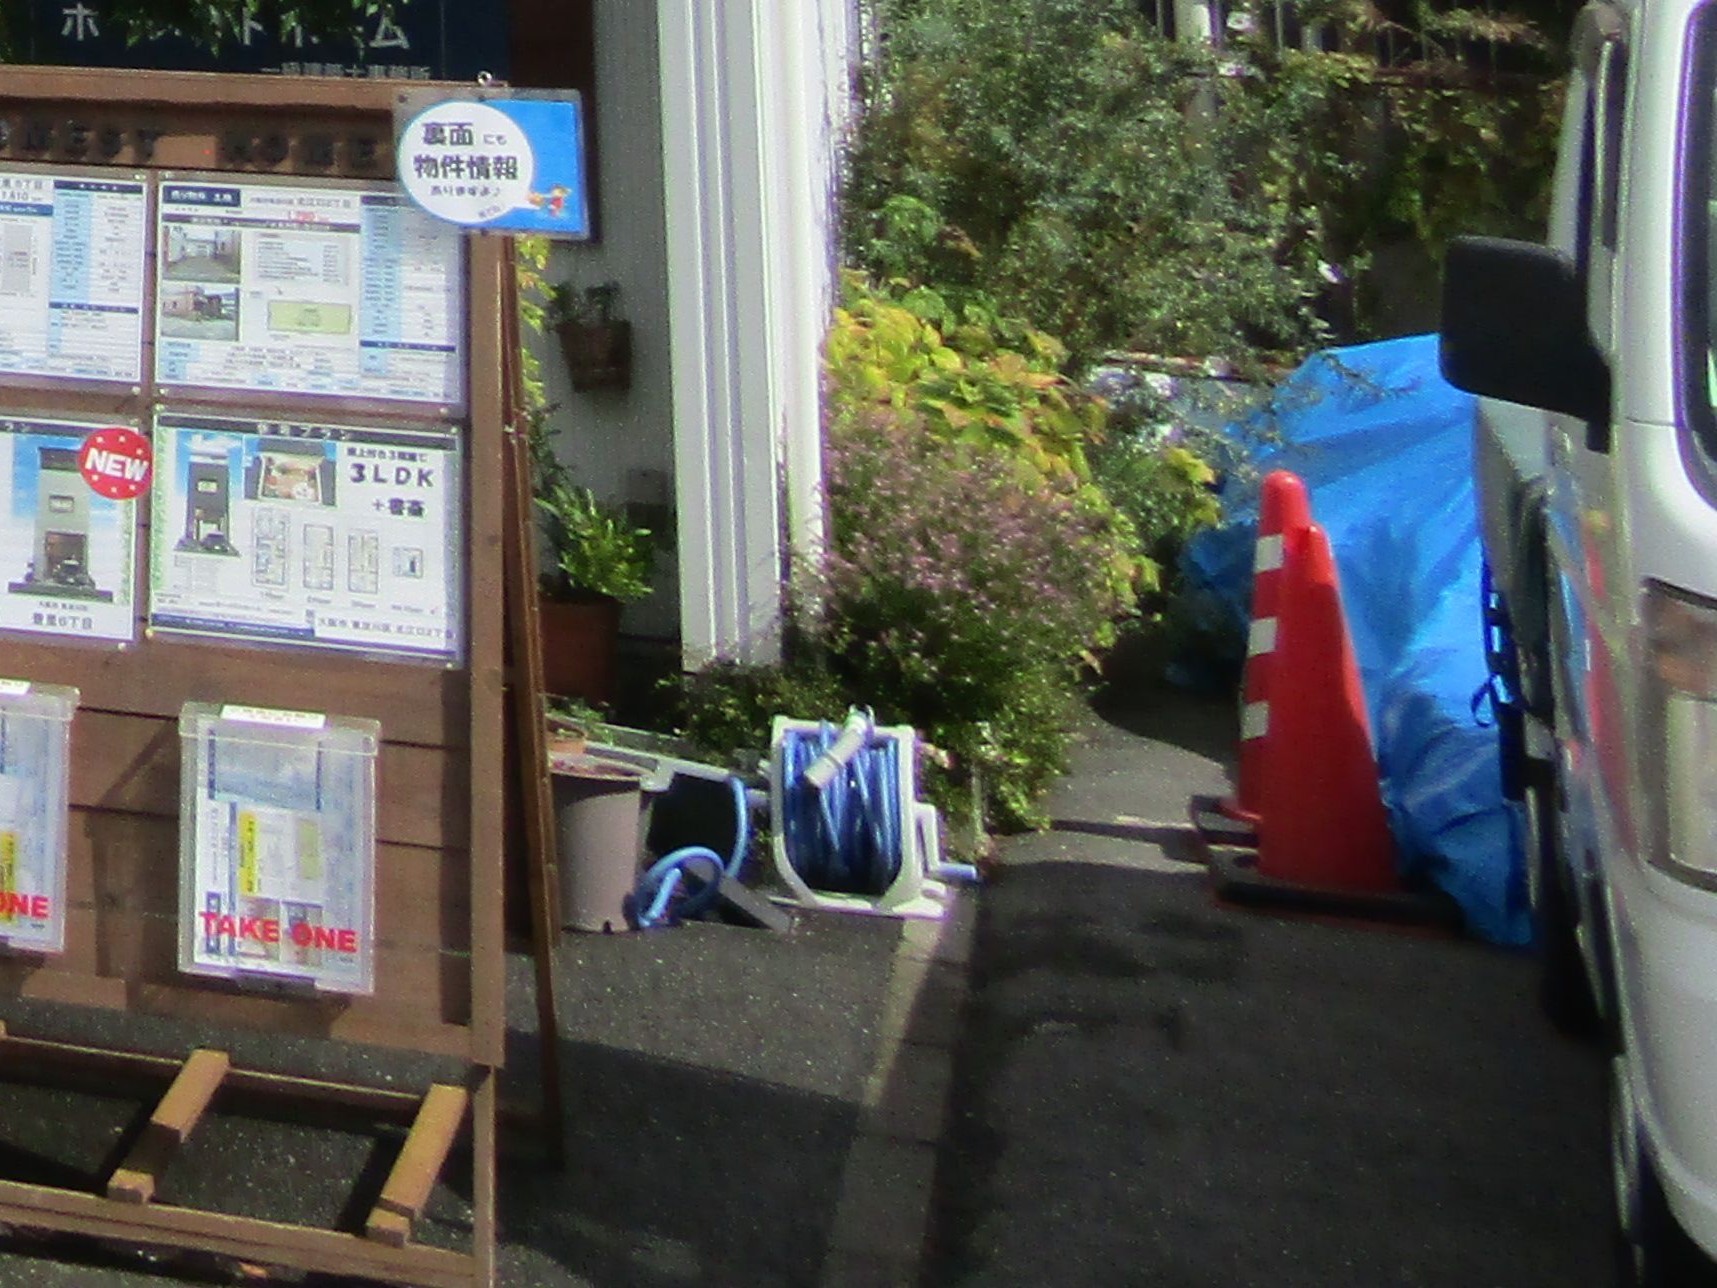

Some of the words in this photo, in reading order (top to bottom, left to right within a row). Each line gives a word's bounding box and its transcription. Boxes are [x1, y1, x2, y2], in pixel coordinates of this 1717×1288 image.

[422, 121, 474, 146] 裏面
[413, 153, 519, 181] 物件情報
[84, 447, 150, 482] NEW
[350, 463, 434, 487] 3LDK
[199, 911, 280, 945] TAKE
[291, 921, 358, 955] ONE
